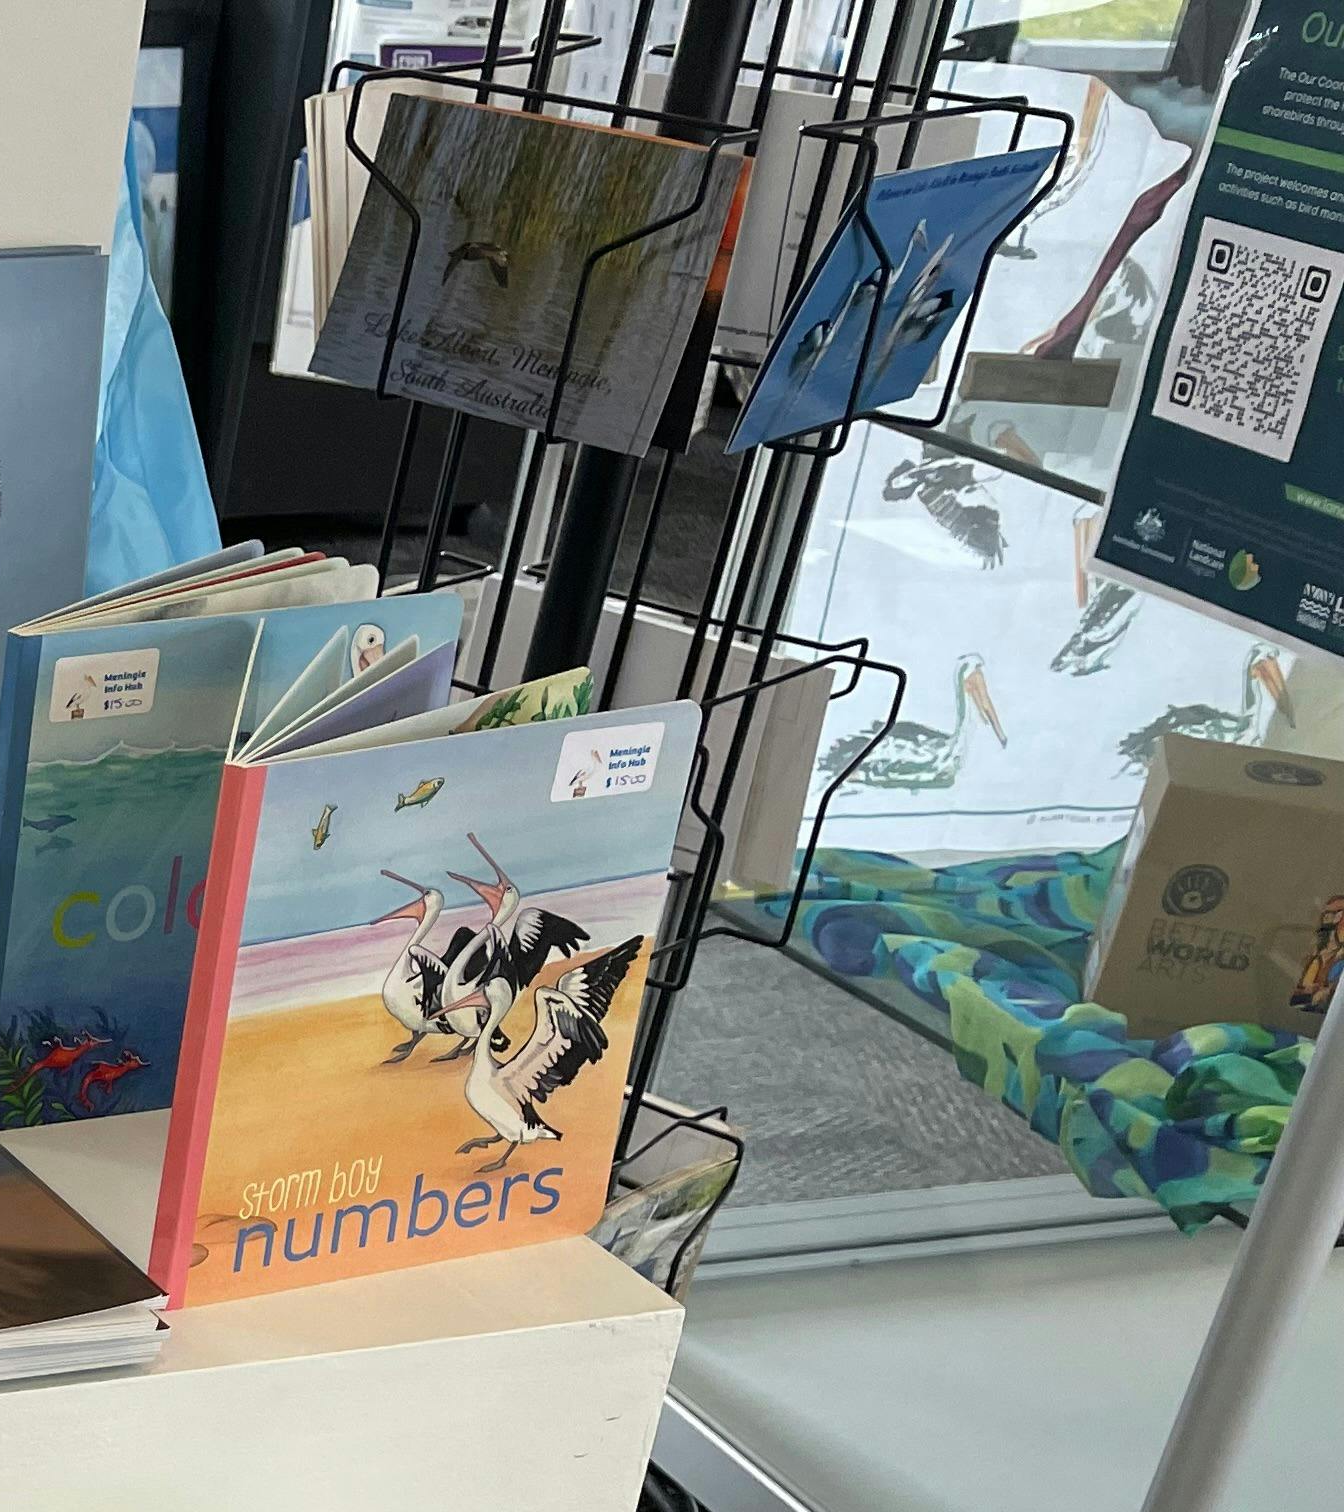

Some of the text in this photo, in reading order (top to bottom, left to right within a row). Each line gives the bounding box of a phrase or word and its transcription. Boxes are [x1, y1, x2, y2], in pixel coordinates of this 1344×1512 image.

[1302, 12, 1344, 48] Ou
[1279, 67, 1344, 91] The Our Coor
[1284, 91, 1340, 111] protect the
[1263, 104, 1344, 135] shorebirds throu
[1226, 163, 1242, 176] The
[1243, 166, 1279, 186] project
[1279, 178, 1328, 199] welcomes
[1219, 181, 1260, 200] activities
[1261, 193, 1283, 207] such
[1285, 199, 1297, 211] as
[1298, 201, 1319, 216] bird
[364, 311, 418, 343] Lke
[104, 670, 147, 682] Meningie
[104, 682, 143, 694] Info Hub
[608, 758, 646, 770] Info Hub
[609, 744, 651, 758] Meningie
[239, 1153, 384, 1221] storm boy
[231, 1165, 565, 1273] numbers
